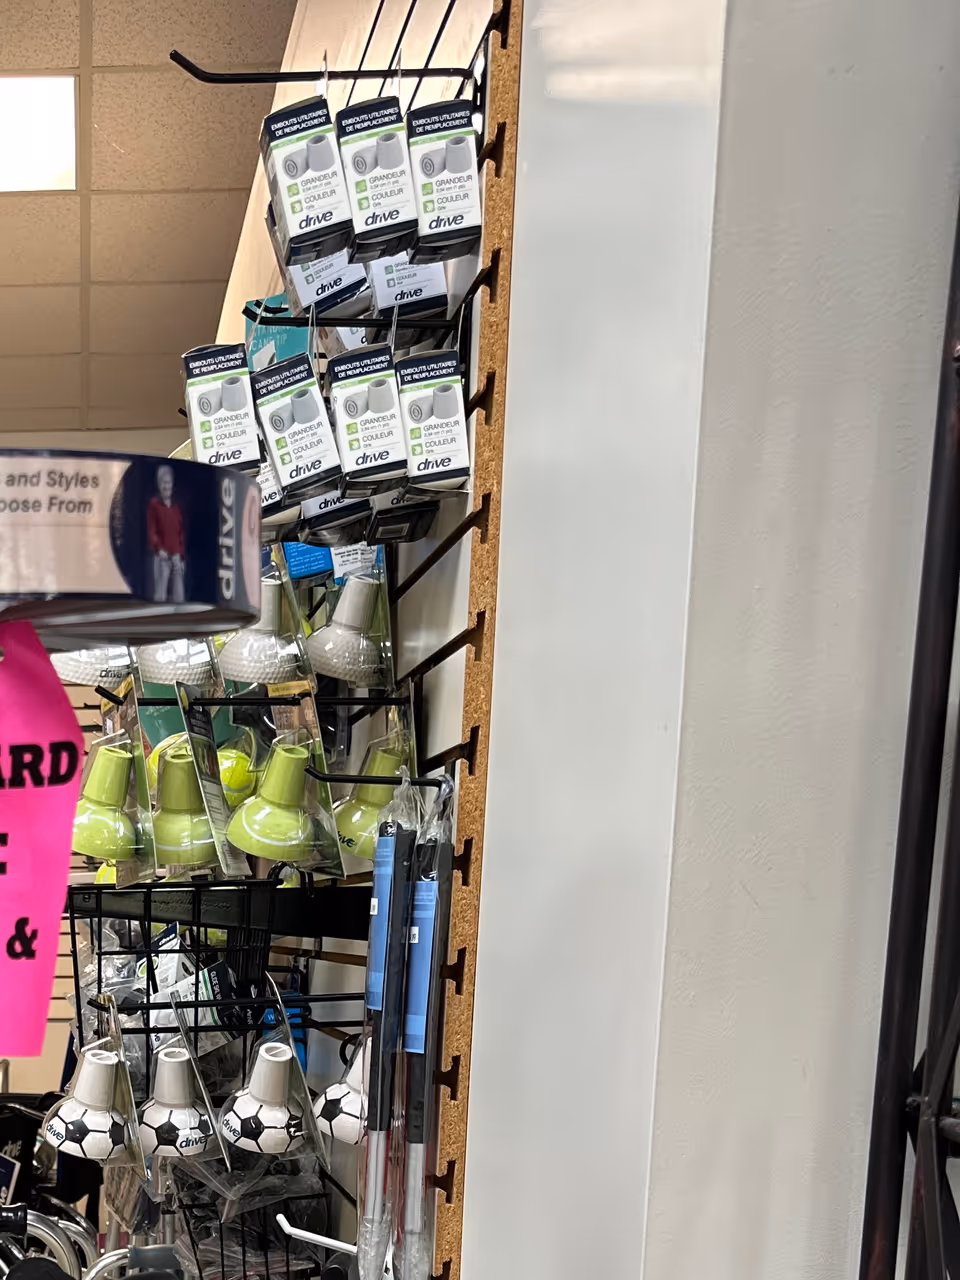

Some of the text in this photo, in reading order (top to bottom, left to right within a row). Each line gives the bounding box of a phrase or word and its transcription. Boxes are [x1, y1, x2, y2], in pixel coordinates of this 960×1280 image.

[275, 128, 284, 136] DE
[346, 124, 354, 132] DE
[416, 125, 424, 134] DE
[301, 170, 338, 187] GRANDEUR
[369, 170, 406, 185] GRANDEUR
[436, 174, 472, 188] GRANDEUR
[304, 189, 336, 204] COULEUR
[372, 188, 404, 202] COULEUR
[436, 192, 469, 204] COULEUR
[298, 210, 333, 230] drive
[364, 209, 400, 226] drive
[428, 214, 464, 230] drive
[316, 278, 342, 296] drive
[394, 288, 422, 302] drive
[338, 370, 346, 378] DE
[404, 374, 412, 382] DE
[214, 412, 249, 424] GRANDEUR
[360, 414, 396, 427] GRANDEUR
[288, 422, 324, 440] GRANDEUR
[423, 420, 460, 432] GRANDEUR
[216, 429, 246, 442] COULEUR
[362, 430, 393, 443] COULEUR
[425, 437, 456, 448] COULEUR
[292, 438, 324, 455] COULEUR
[208, 450, 242, 464] drive
[355, 450, 390, 466] drive
[417, 457, 452, 472] drive
[290, 459, 322, 480] drive
[5, 470, 41, 488] and
[46, 472, 100, 492] Styles
[46, 496, 93, 514] From
[217, 476, 236, 600] drive
[6, 916, 38, 960] &
[47, 1124, 64, 1141] drive
[222, 1118, 241, 1138] drive
[179, 1135, 208, 1149] drive
